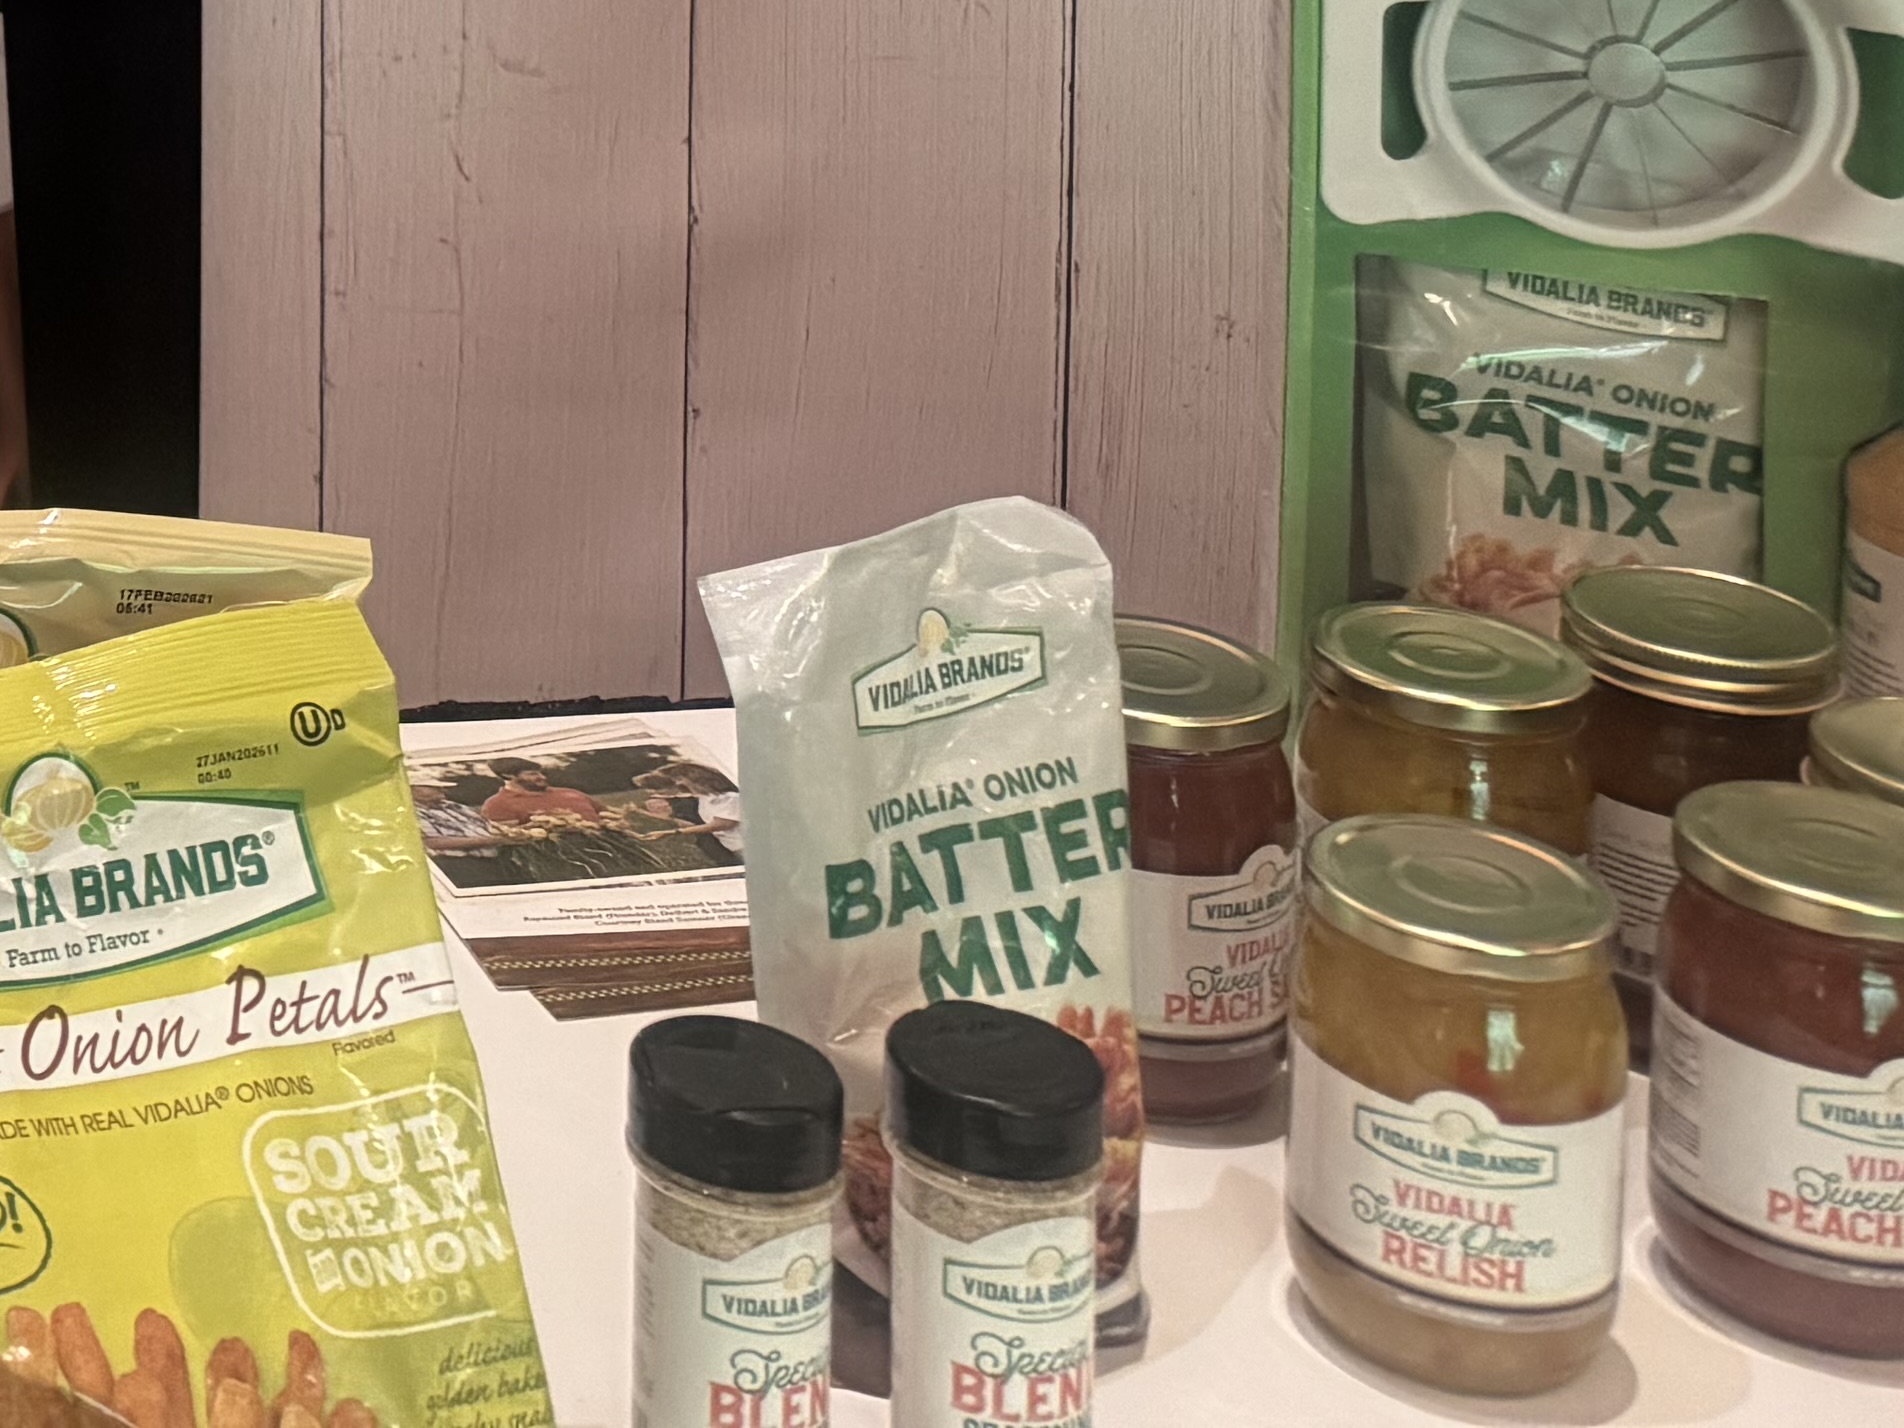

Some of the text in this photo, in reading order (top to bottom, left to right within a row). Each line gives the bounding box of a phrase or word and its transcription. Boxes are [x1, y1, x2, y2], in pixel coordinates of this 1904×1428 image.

[1507, 271, 1600, 309] VIDALIA
[1405, 371, 1763, 495] BATTER
[1612, 383, 1715, 422] ONION
[1503, 454, 1680, 547] MIX
[868, 666, 937, 714] VIDALIA
[938, 648, 1025, 690] BRANDS
[983, 756, 1079, 803] ONION
[824, 788, 1132, 939] BATTER
[5, 928, 151, 969] Farm to Flavor
[919, 897, 1101, 1004] MIX
[1163, 993, 1262, 1026] PEACH
[20, 1004, 200, 1082] Onion
[31, 1113, 79, 1138] WITH
[82, 1106, 131, 1133] REAL
[235, 1075, 314, 1105] ONIONS
[264, 1112, 471, 1194] SOUR
[286, 1168, 488, 1242] CREAM
[1393, 1178, 1518, 1231] VIDALIA
[1766, 1188, 1903, 1248] PEACH
[343, 1221, 515, 1289] ONION
[1381, 1230, 1526, 1294] RELISH
[722, 1294, 799, 1318] VIDALIA
[961, 1275, 1045, 1305] VIDALIA
